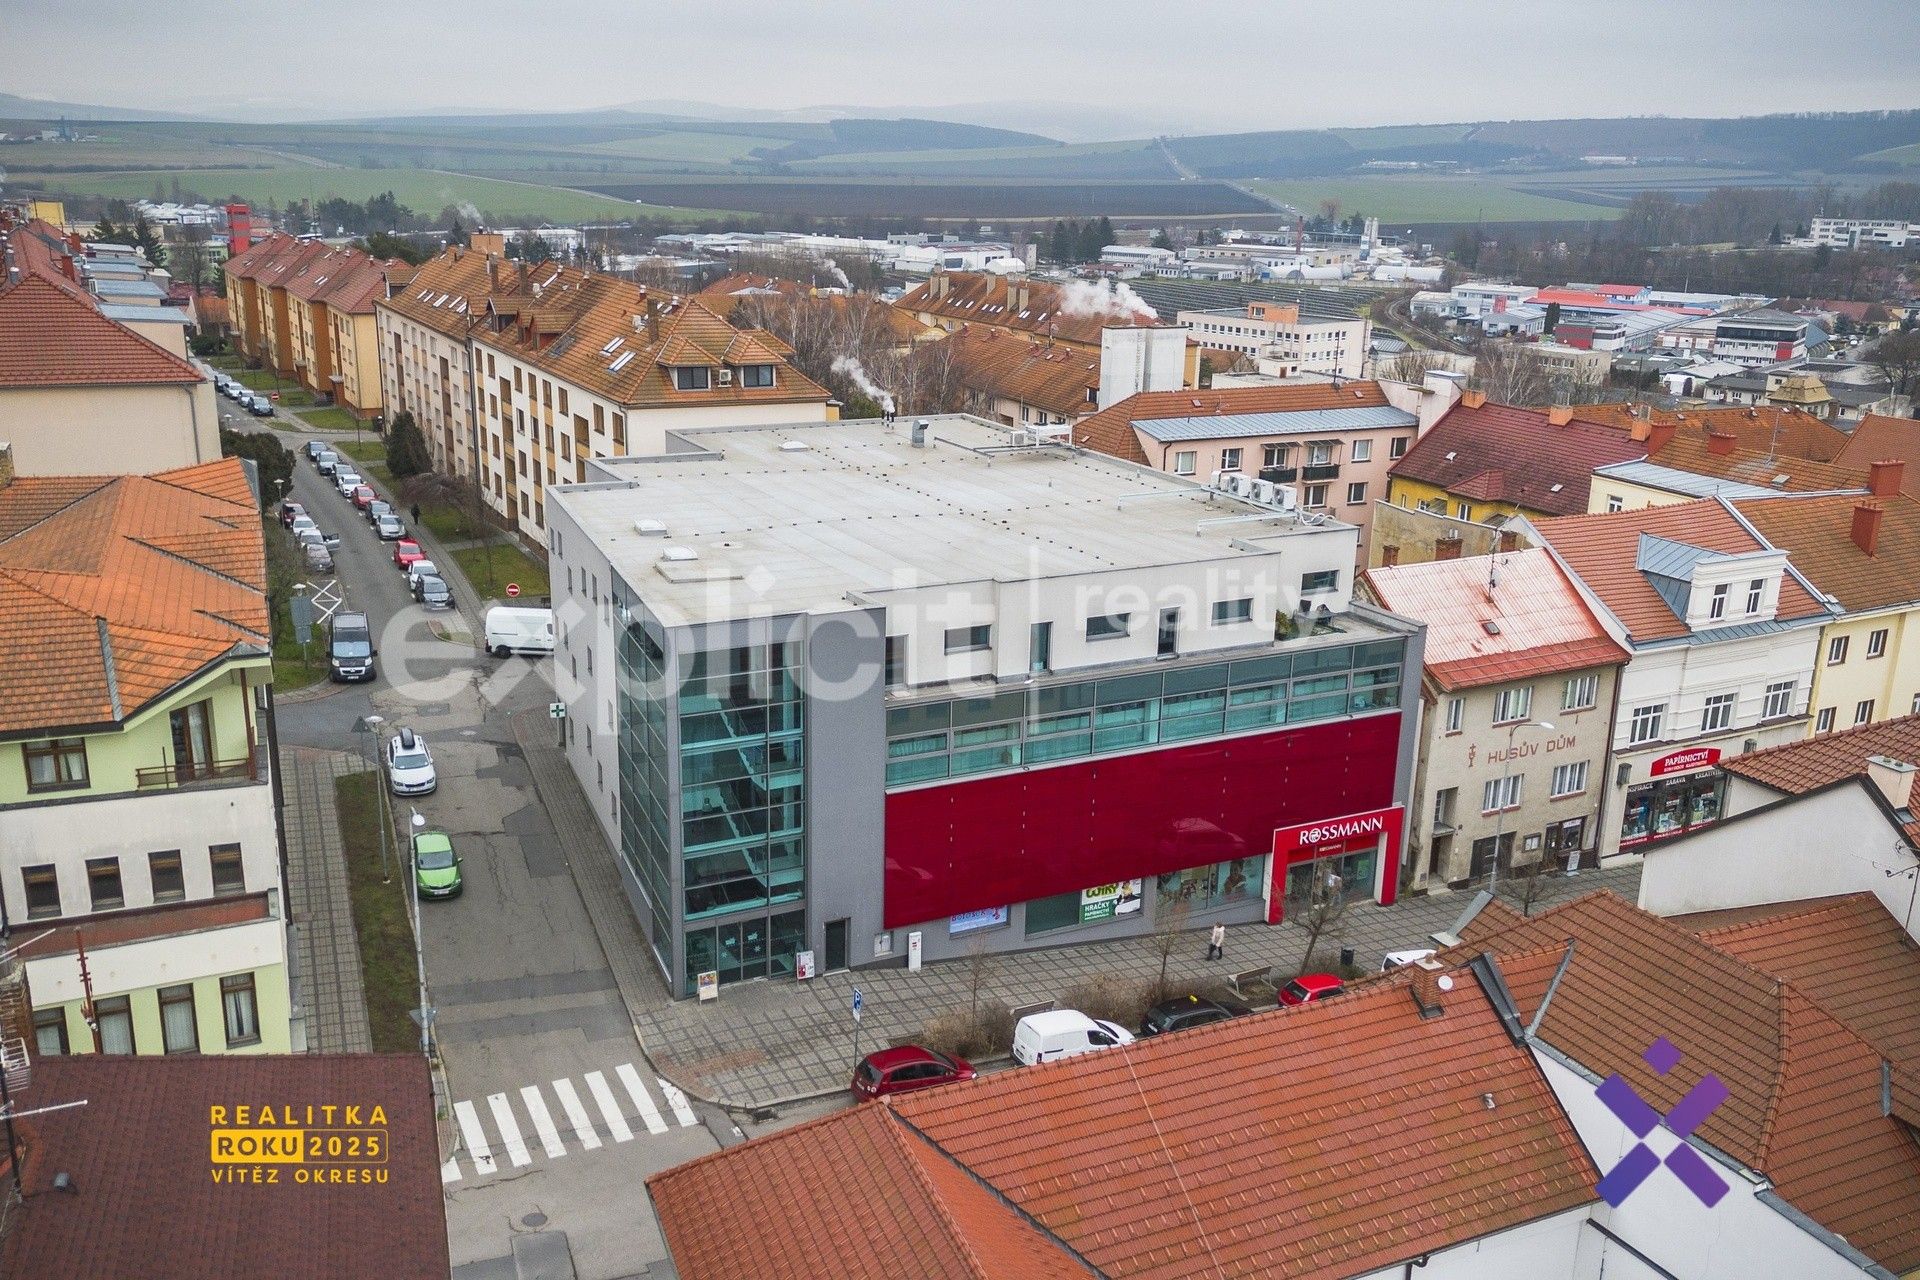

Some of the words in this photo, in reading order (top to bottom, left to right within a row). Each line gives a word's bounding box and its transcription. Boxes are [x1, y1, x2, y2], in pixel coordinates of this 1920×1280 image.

[1488, 741, 1539, 764] HUSŮV
[1546, 734, 1576, 753] DŮM
[1664, 749, 1709, 766] PAPÍRNICTVÍ
[1300, 816, 1384, 845] ROSSMANN
[1084, 901, 1110, 912] HRAČKY
